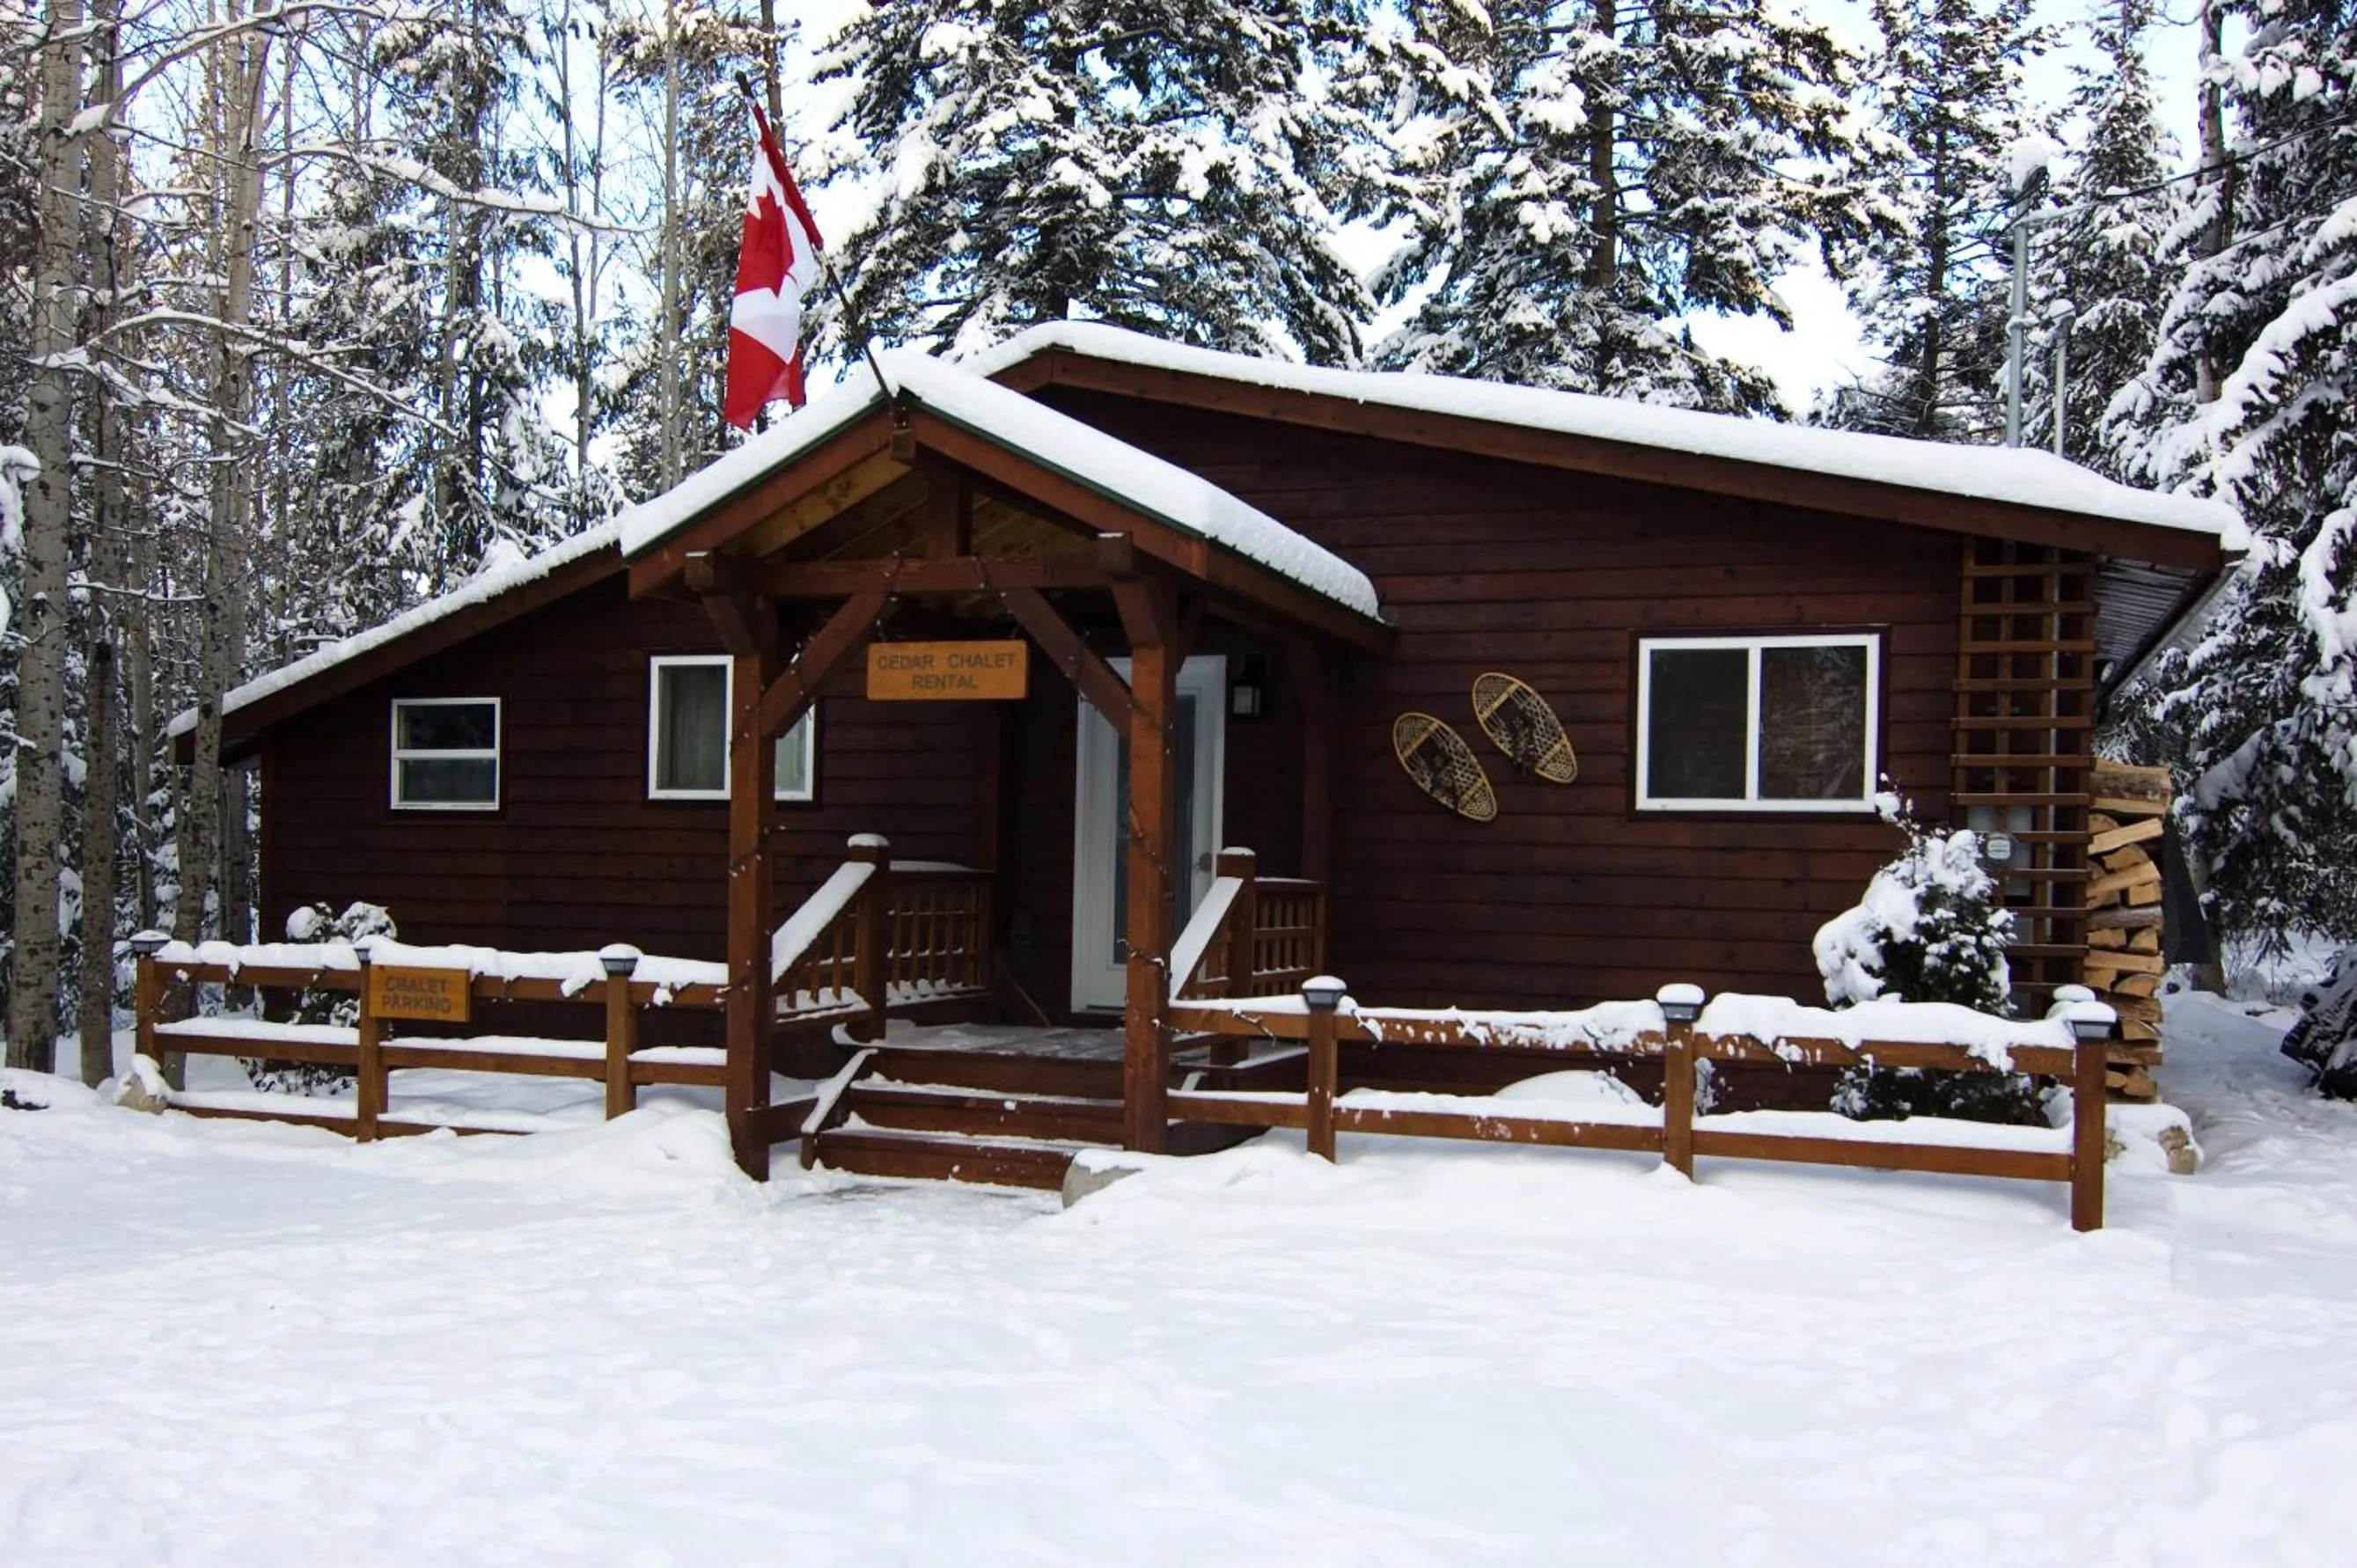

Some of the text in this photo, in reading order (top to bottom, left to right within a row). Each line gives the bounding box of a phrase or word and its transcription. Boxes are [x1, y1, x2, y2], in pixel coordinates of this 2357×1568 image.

[877, 652, 1016, 670] CEDAR CHALET
[912, 674, 978, 690] RENTAL
[385, 976, 447, 993] CHALET
[382, 995, 451, 1013] PARKING
